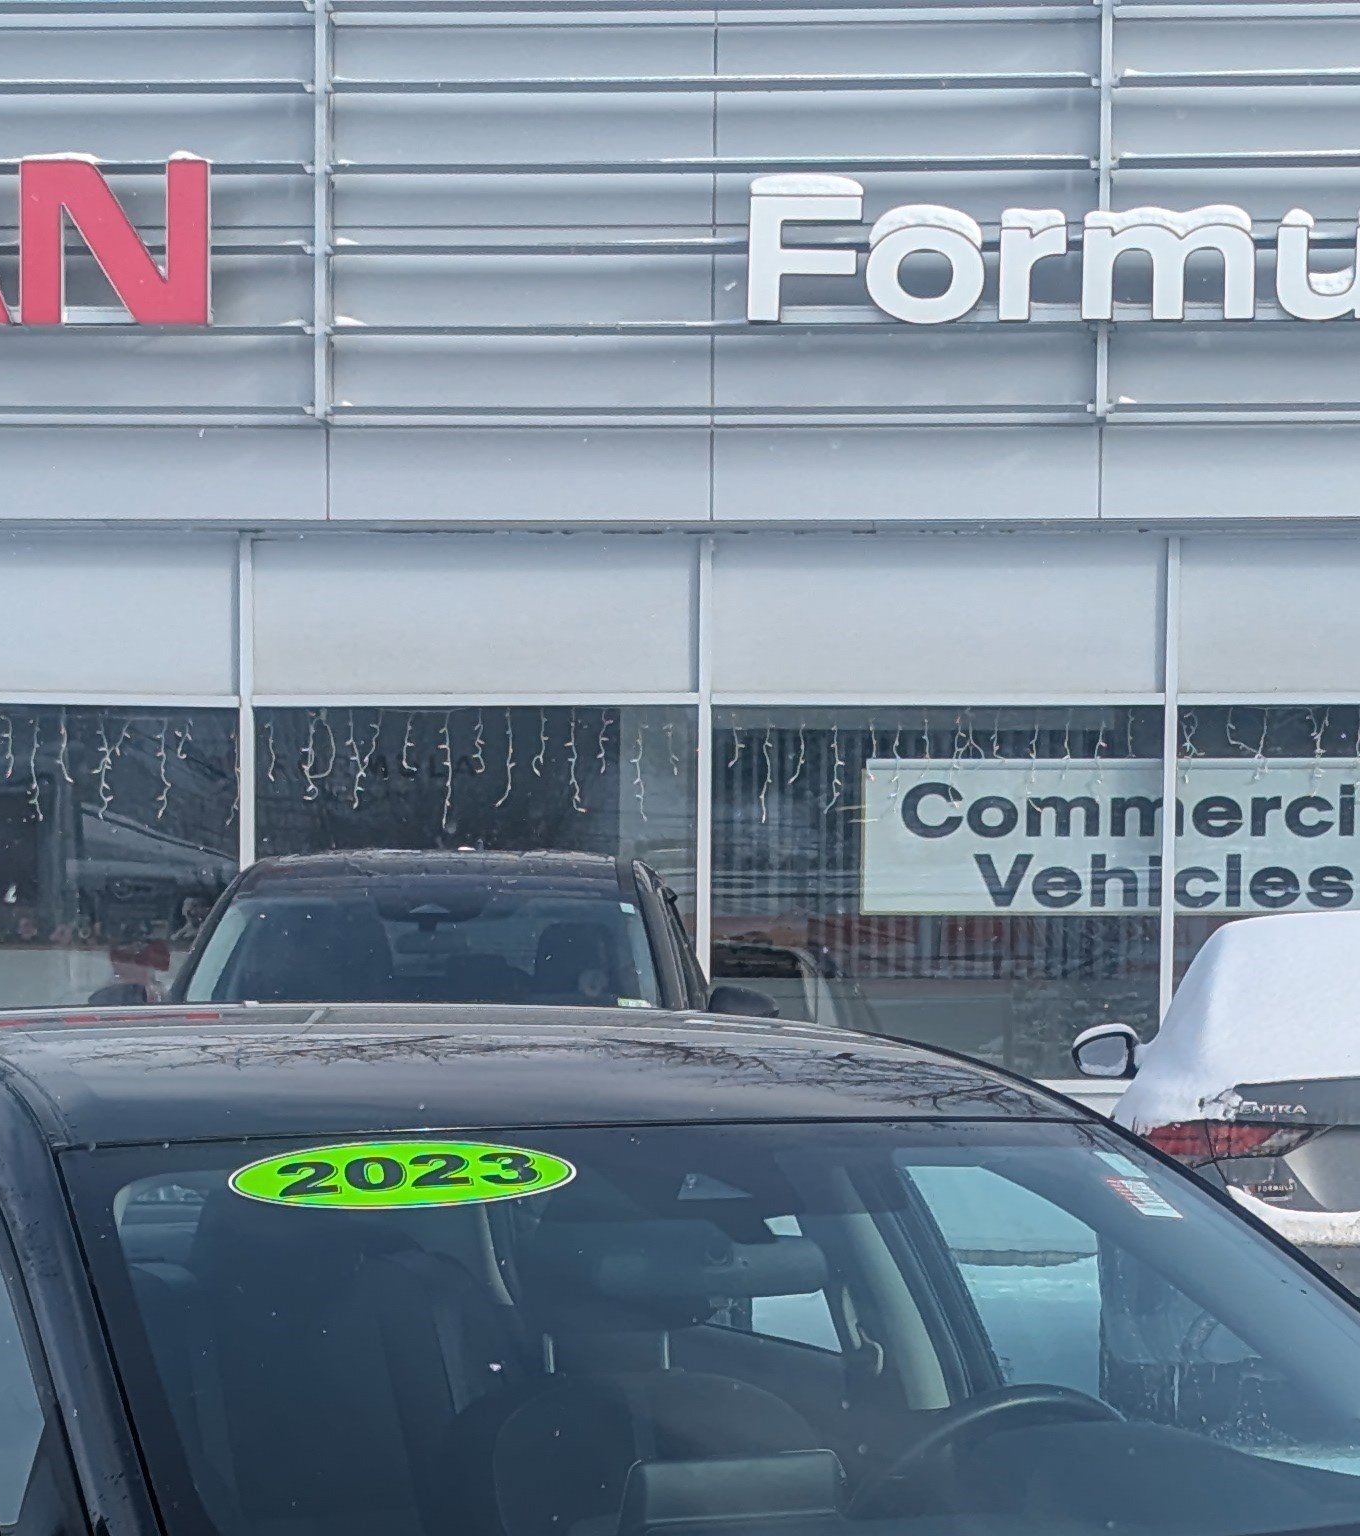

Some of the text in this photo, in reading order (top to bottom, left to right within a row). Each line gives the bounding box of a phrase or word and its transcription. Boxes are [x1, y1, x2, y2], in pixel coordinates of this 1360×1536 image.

[973, 853, 1355, 908] Vehicles
[1226, 1102, 1308, 1114] ENTRA
[226, 1150, 543, 1199] 2023
